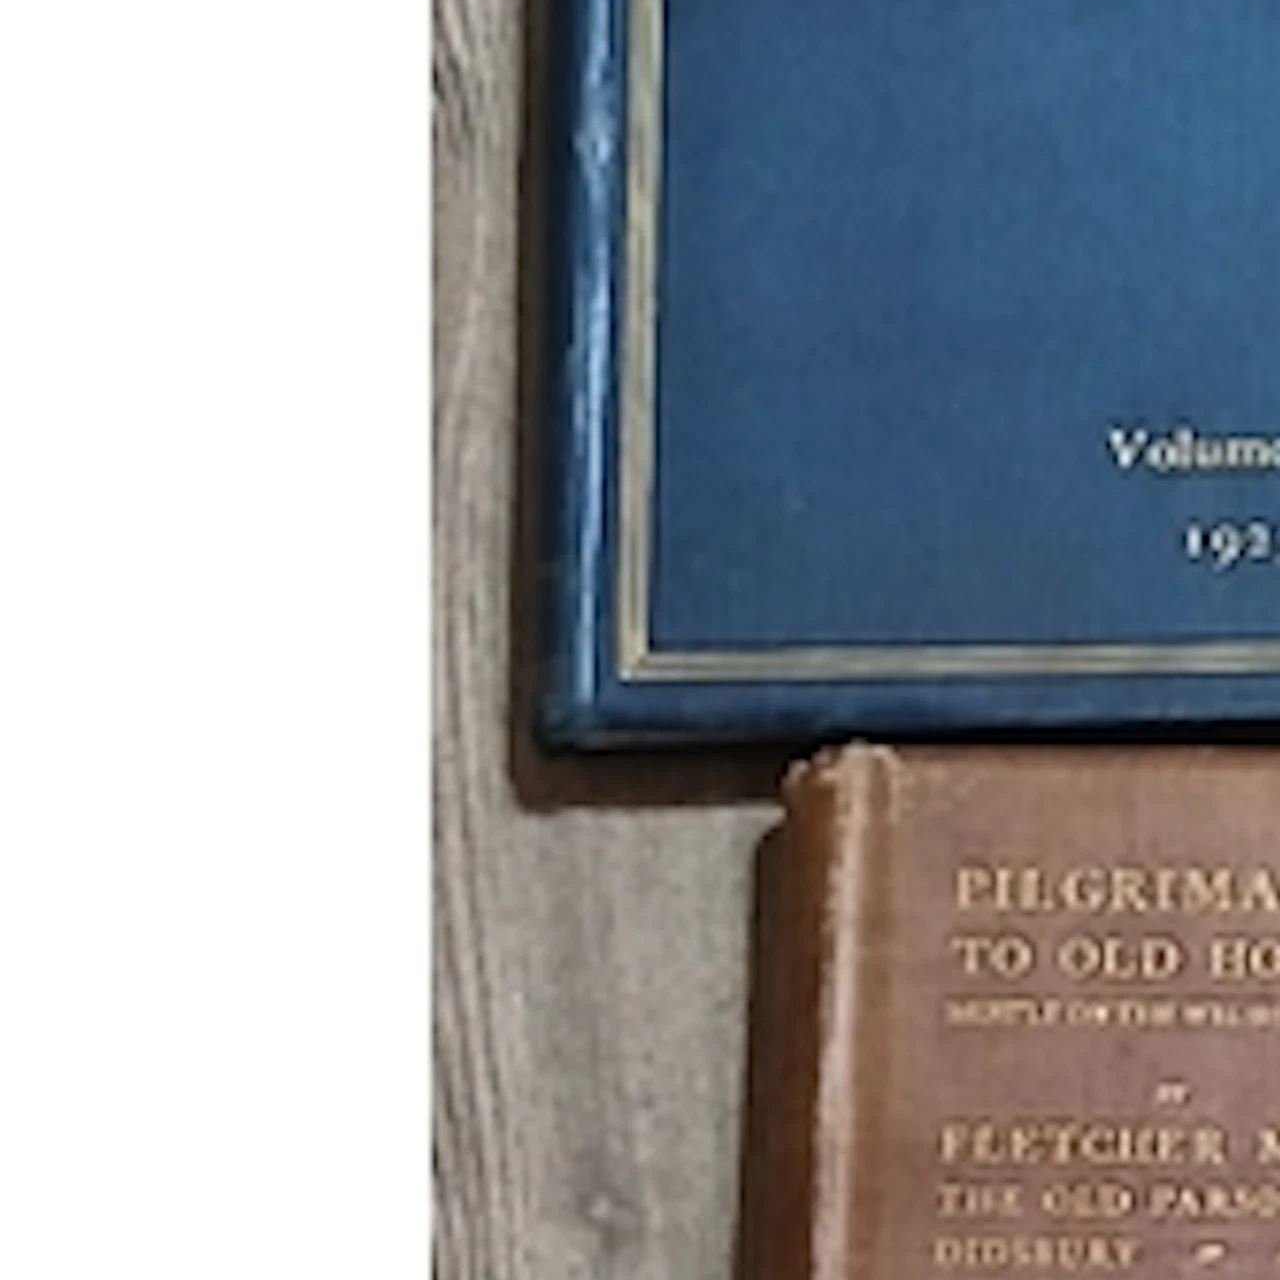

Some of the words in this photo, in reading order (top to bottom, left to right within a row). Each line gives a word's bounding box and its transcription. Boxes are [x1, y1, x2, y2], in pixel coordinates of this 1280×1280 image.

[951, 936, 1034, 980] TO
[1059, 937, 1185, 980] OLD
[939, 1126, 1227, 1165] FLETCHER
[937, 1186, 1025, 1216] THE
[1042, 1186, 1136, 1217] OLD
[933, 1237, 1139, 1270] DIDSBURY
